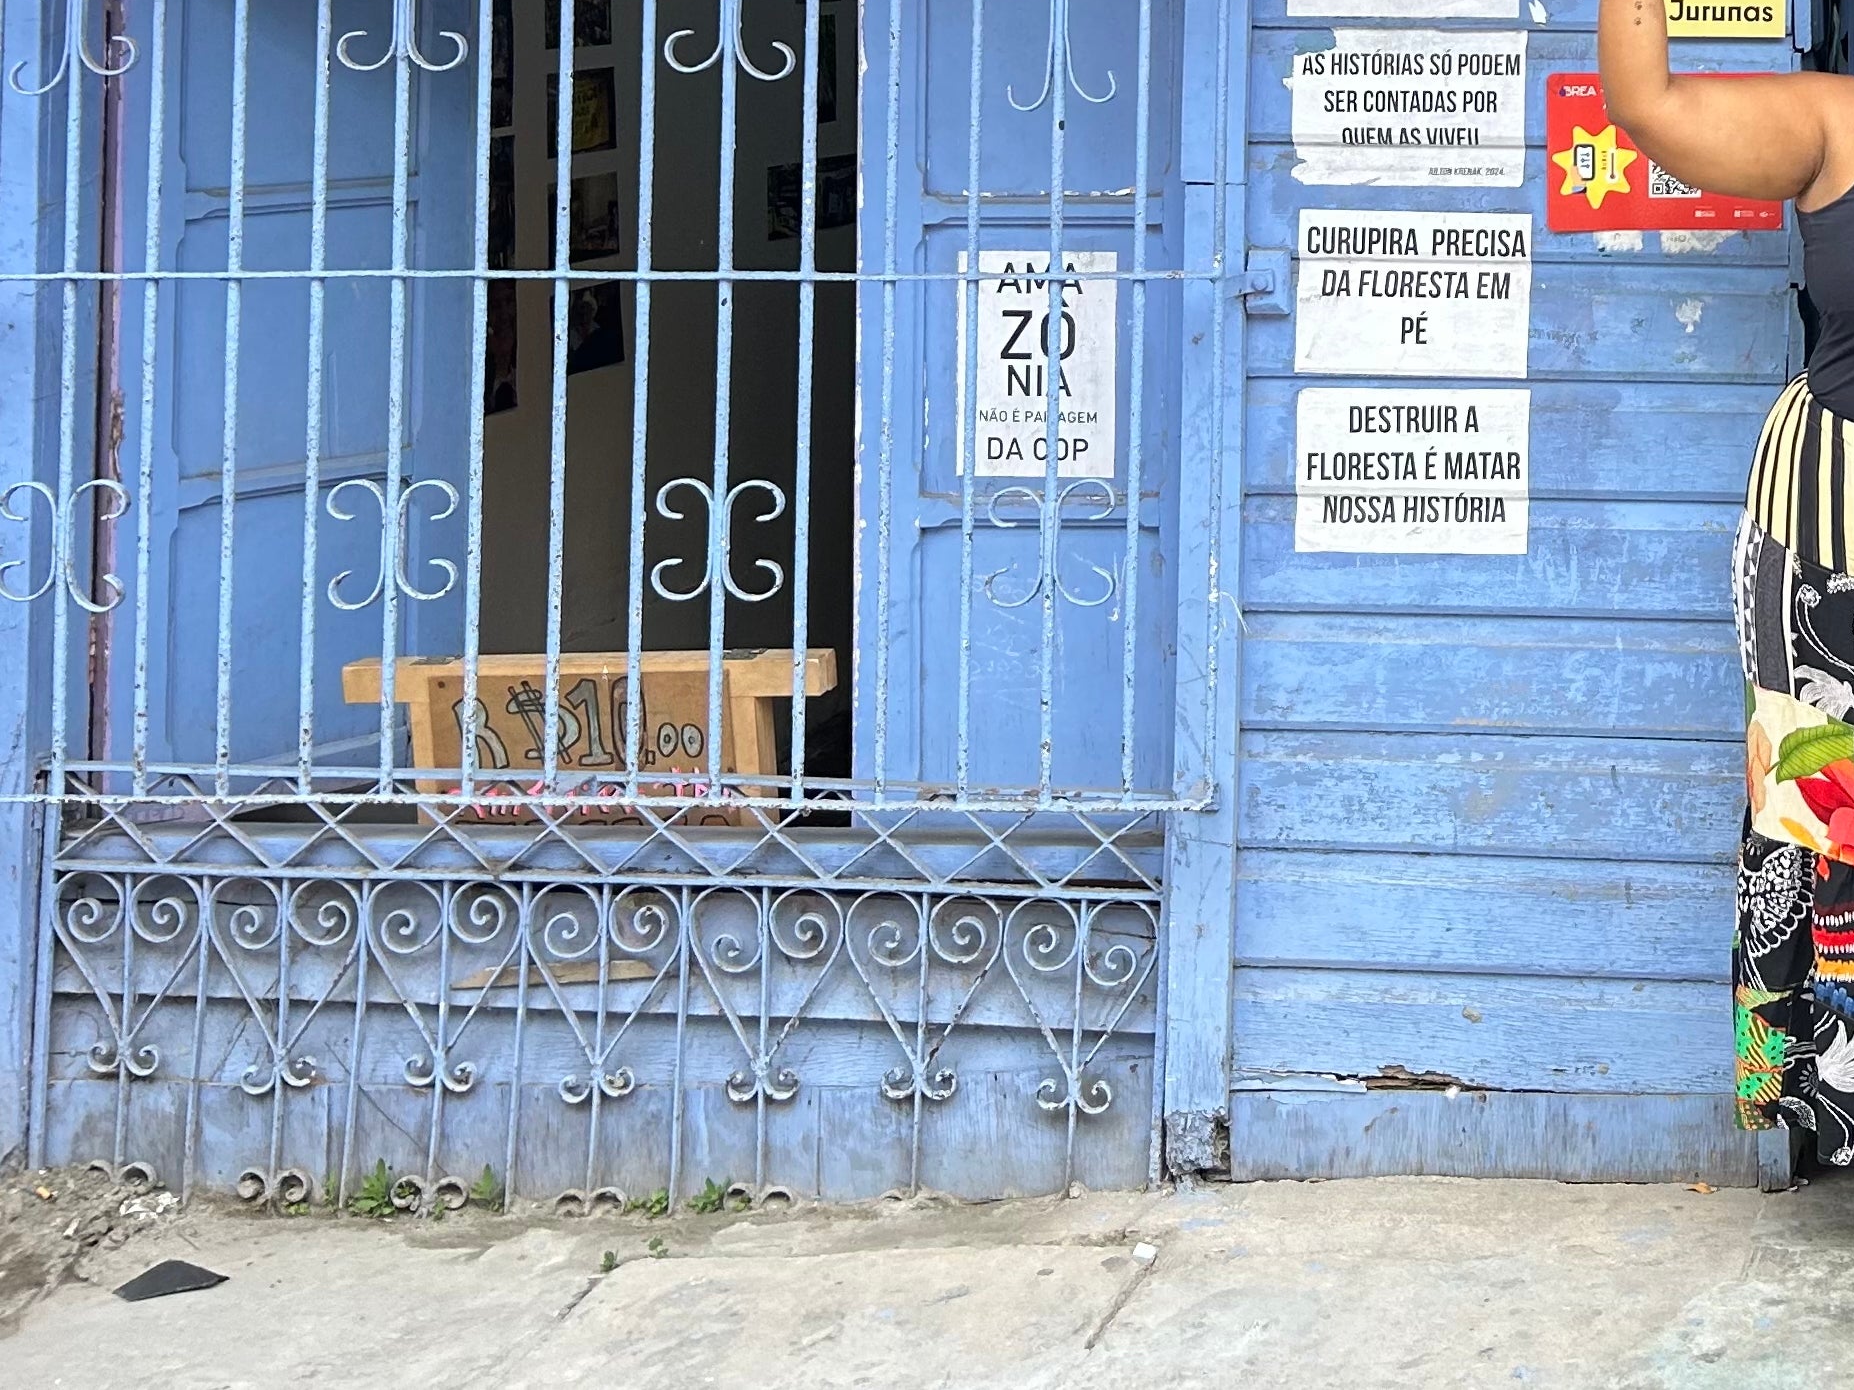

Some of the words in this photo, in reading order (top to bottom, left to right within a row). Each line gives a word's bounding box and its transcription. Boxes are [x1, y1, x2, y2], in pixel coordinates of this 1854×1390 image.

[1301, 53, 1326, 76] AS
[1330, 48, 1425, 76] HISTÓRIAS
[1429, 48, 1452, 76] SÓ
[1457, 53, 1522, 76] PODEM
[1323, 90, 1358, 113] SER
[1363, 90, 1457, 113] CONTADAS
[1462, 90, 1498, 113] POR
[1341, 127, 1393, 146] QUEM
[1399, 127, 1421, 146] AS
[1307, 225, 1419, 256] CURUPIRA
[1431, 228, 1527, 258] PRECISA
[1321, 269, 1351, 297] DA
[1358, 269, 1470, 299] FLORESTA
[1476, 272, 1511, 300] EM
[1400, 310, 1429, 345] PÉ
[979, 407, 1008, 423] NÃO
[1012, 407, 1020, 423] É
[1025, 411, 1098, 424] PAIAGEM
[1349, 405, 1458, 433] DESTRUIR
[1464, 405, 1479, 433] A
[987, 437, 1024, 461] DA
[1307, 451, 1418, 481] FLORESTA
[1425, 446, 1437, 480] É
[1444, 451, 1521, 480] MATAR
[1322, 495, 1396, 524] NOSSA
[1402, 492, 1506, 523] HISTÓRIA
